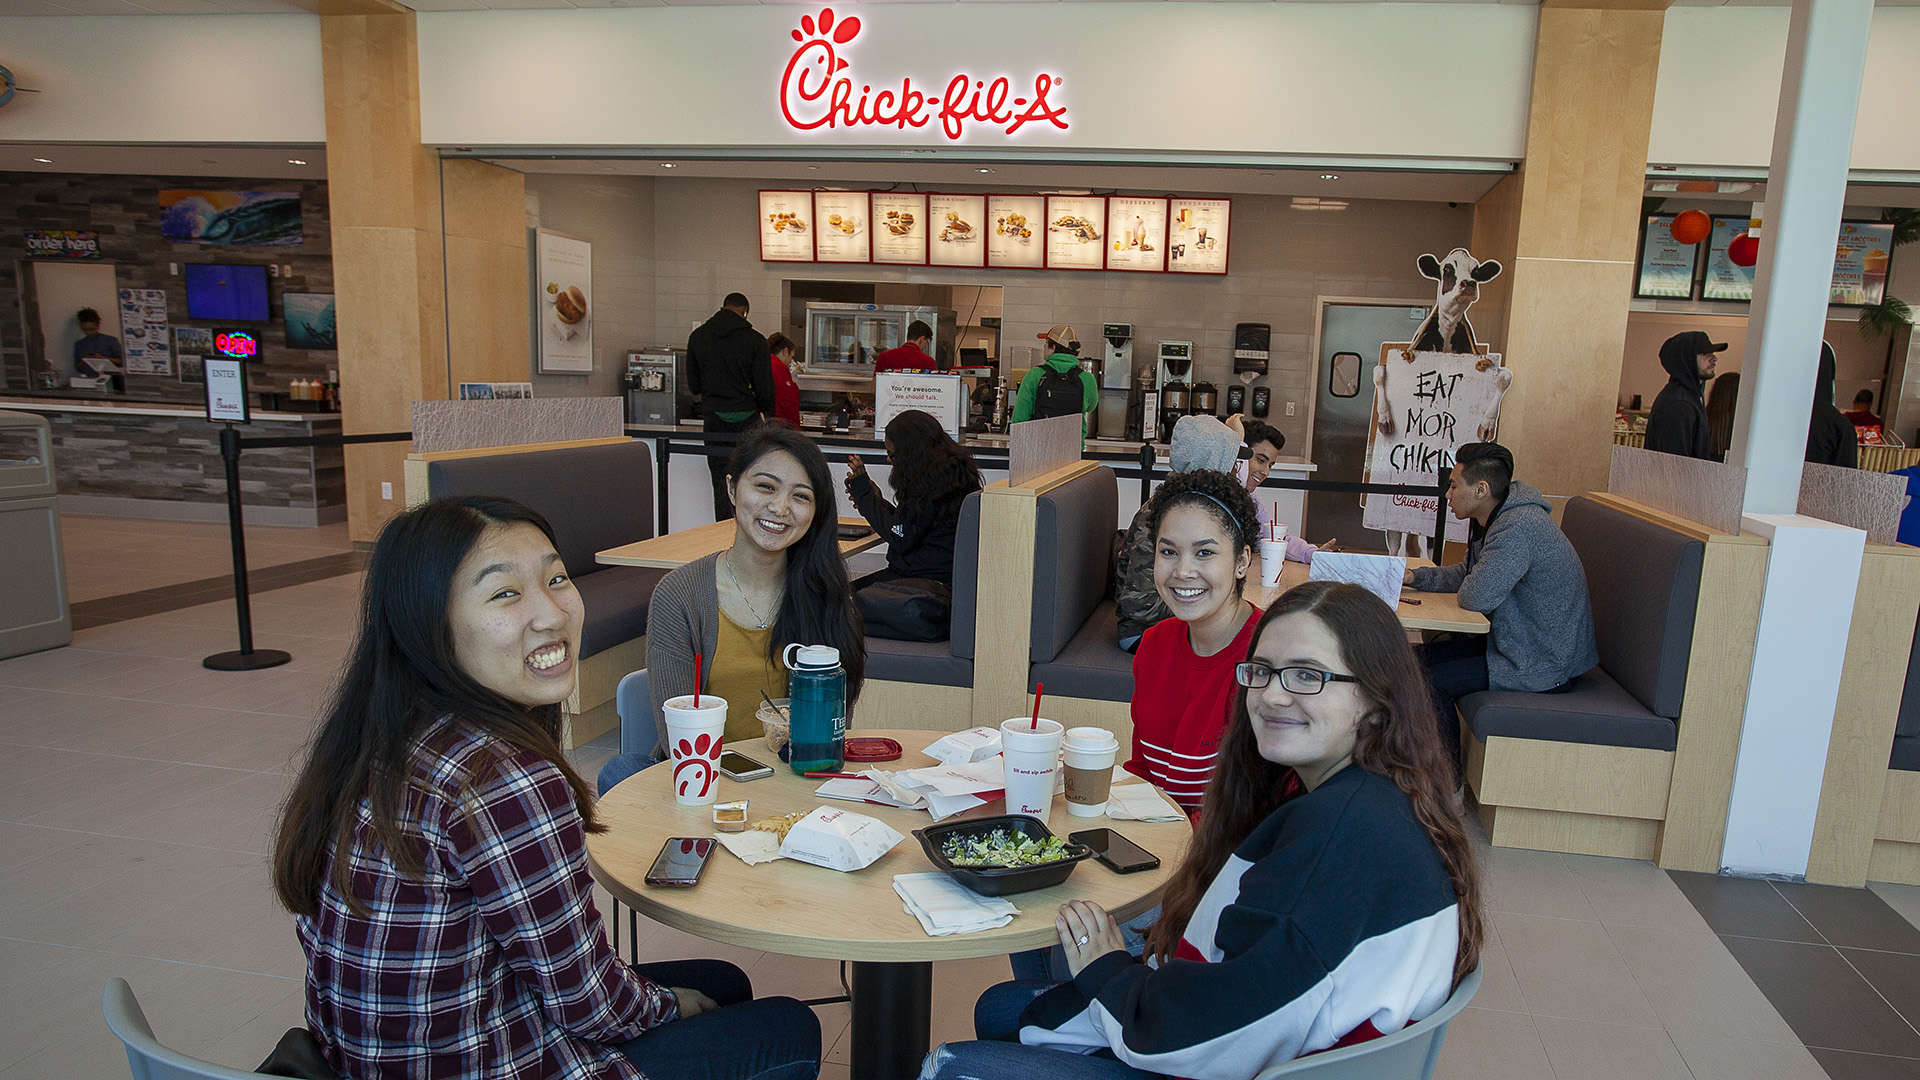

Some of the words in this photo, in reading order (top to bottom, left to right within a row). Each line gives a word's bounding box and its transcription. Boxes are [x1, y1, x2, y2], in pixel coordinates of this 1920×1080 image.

[780, 38, 1069, 139] Chick-fil-A
[28, 235, 64, 249] order
[66, 235, 97, 251] here
[215, 333, 257, 356] OPEN
[212, 369, 237, 378] ENTER
[1413, 370, 1464, 402] EAT
[1405, 408, 1457, 444] MOR
